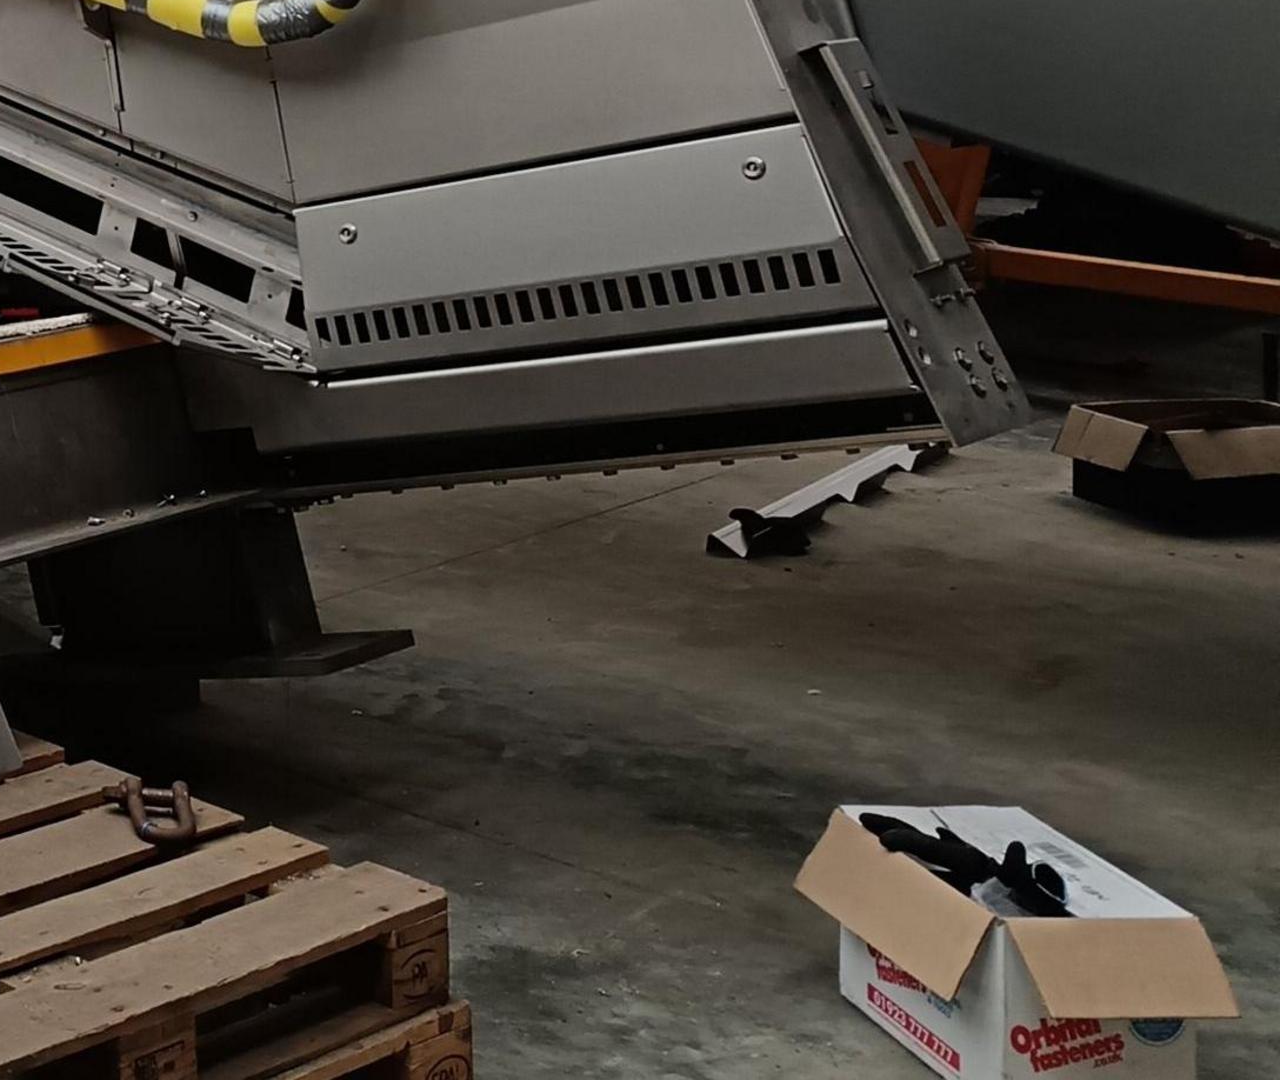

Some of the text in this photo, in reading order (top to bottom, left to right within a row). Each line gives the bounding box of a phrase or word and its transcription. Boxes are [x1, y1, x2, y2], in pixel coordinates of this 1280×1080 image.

[873, 990, 907, 1026] 01923
[907, 1017, 930, 1044] 777
[933, 1036, 953, 1062] 777
[1010, 1018, 1102, 1054] Orbital
[1030, 1032, 1125, 1073] fasteners
